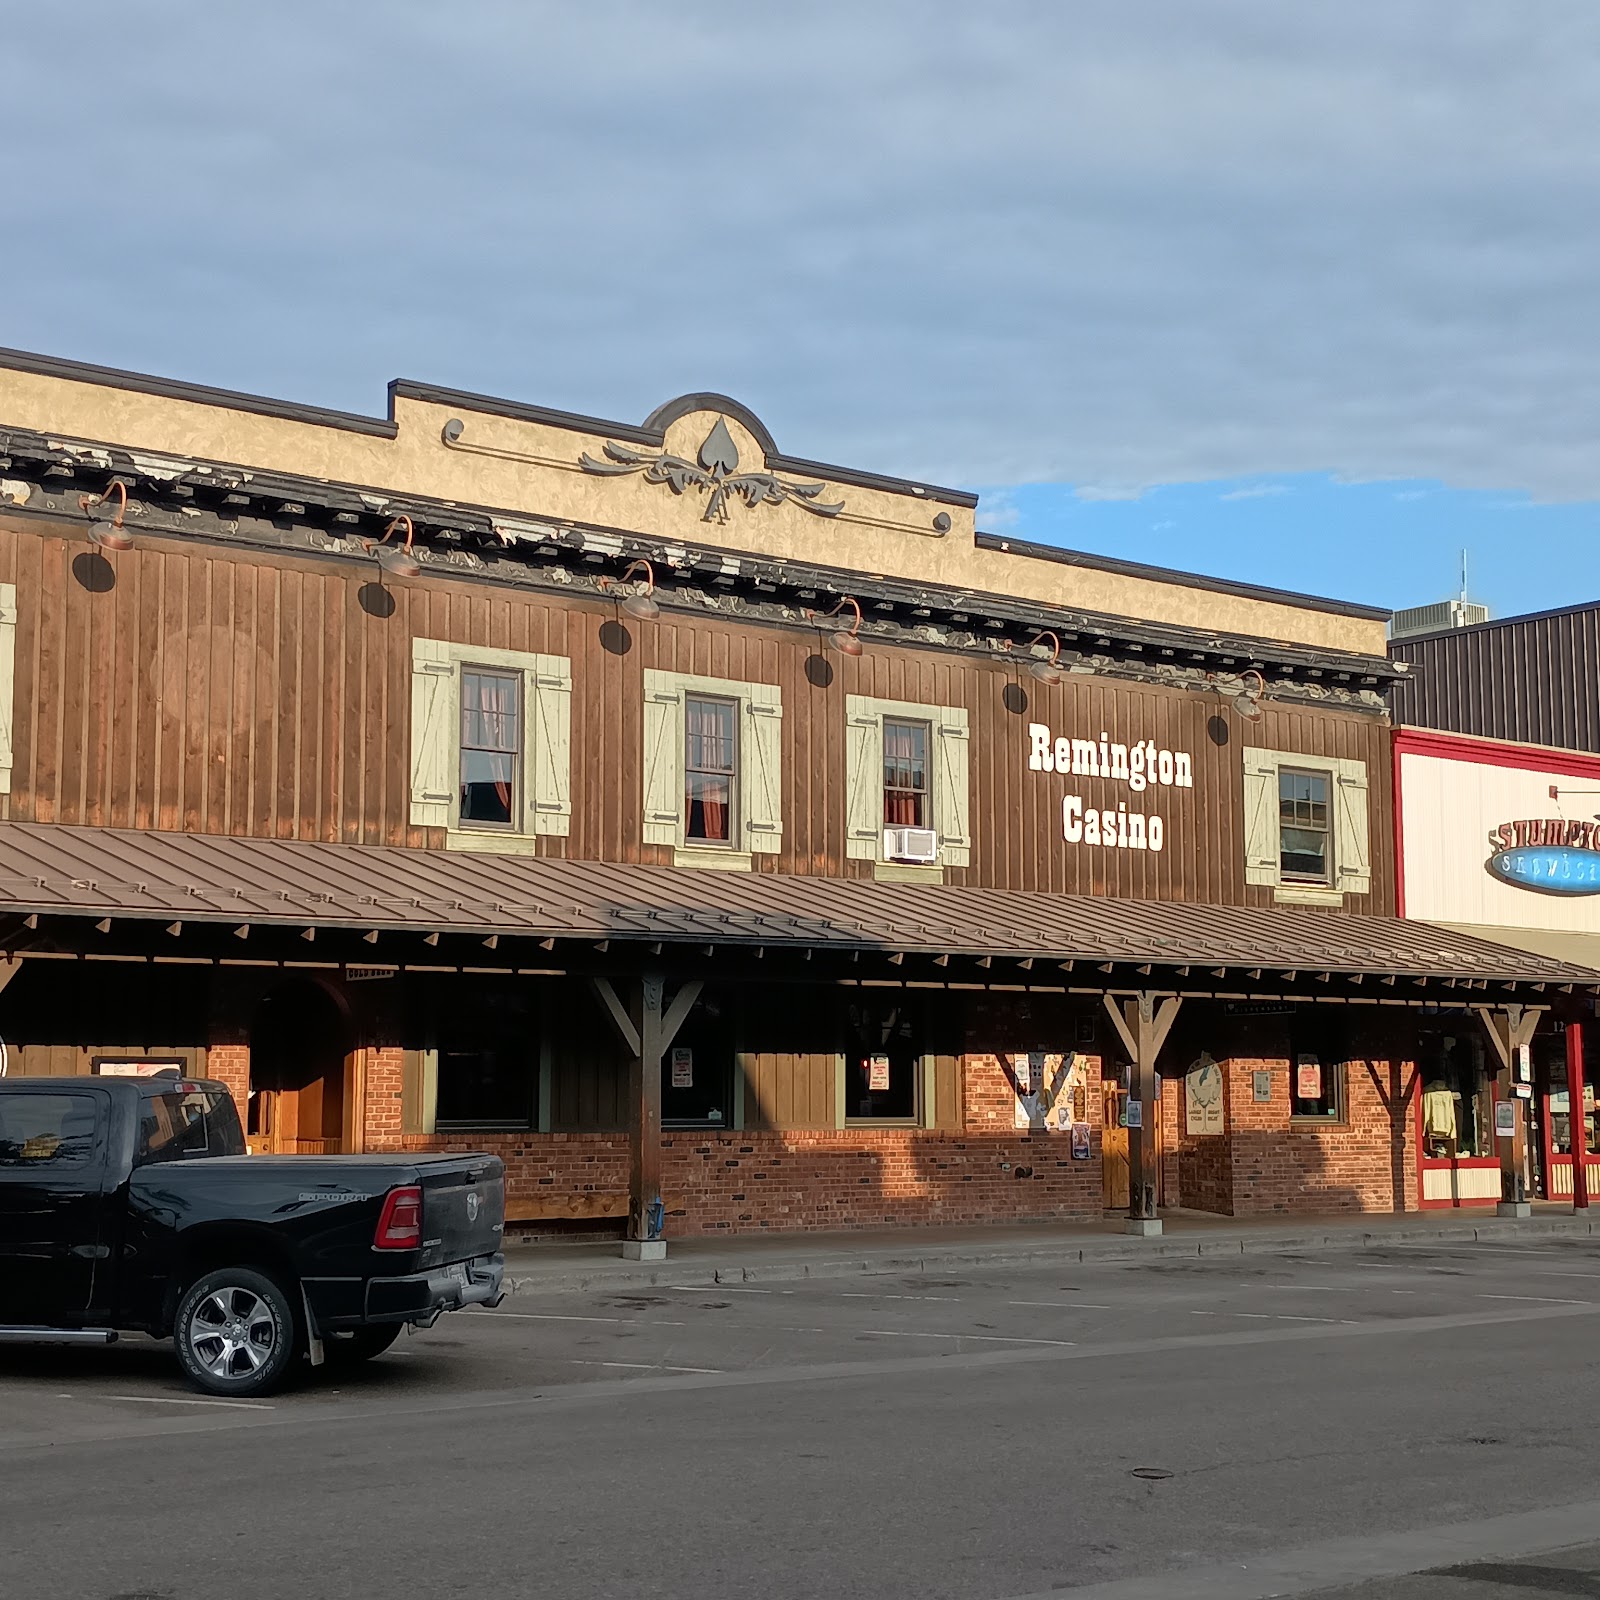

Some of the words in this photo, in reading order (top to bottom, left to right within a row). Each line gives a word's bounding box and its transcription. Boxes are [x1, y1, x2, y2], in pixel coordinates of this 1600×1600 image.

[1028, 722, 1193, 792] Remington
[1062, 794, 1164, 852] Casino
[1553, 1020, 1567, 1033] 12
[298, 1192, 372, 1202] SPORT
